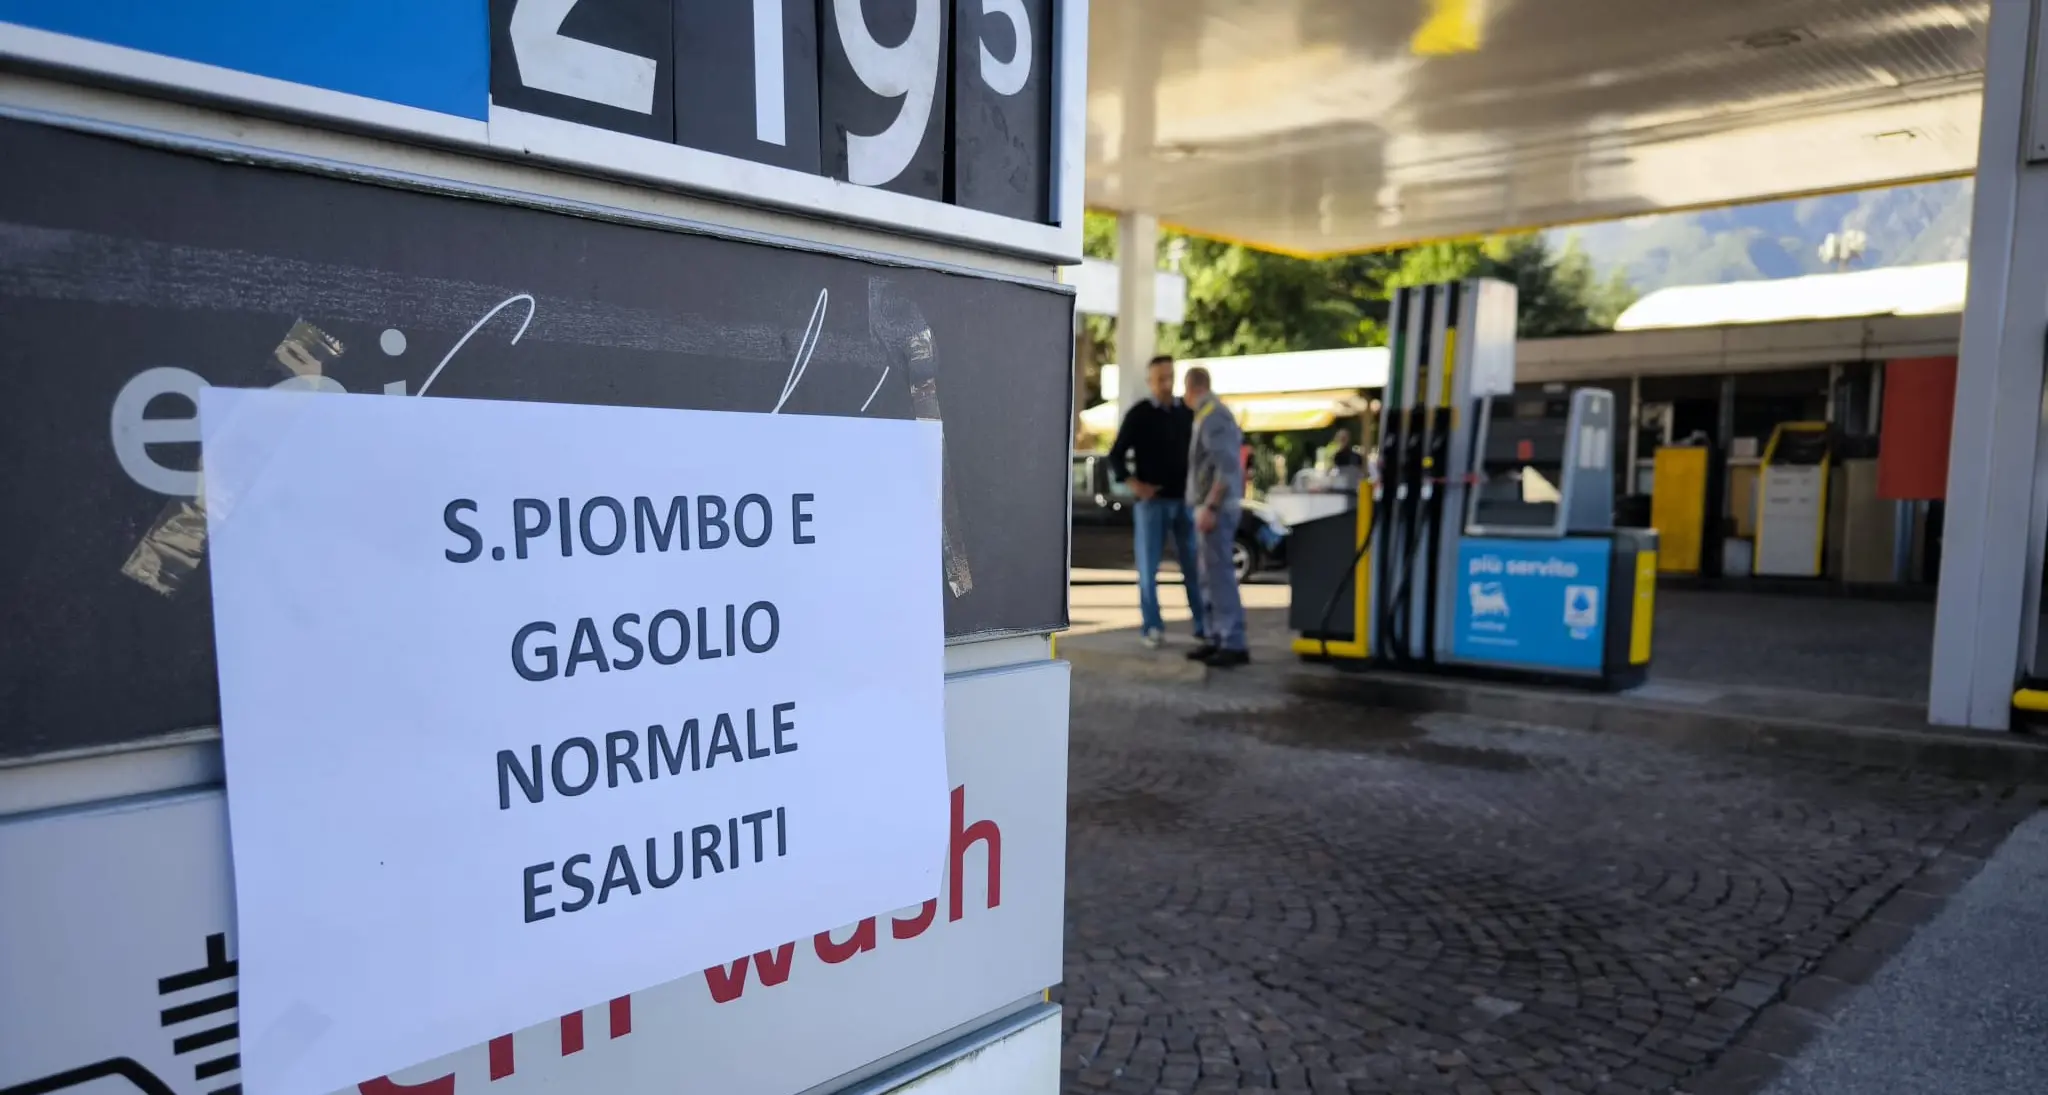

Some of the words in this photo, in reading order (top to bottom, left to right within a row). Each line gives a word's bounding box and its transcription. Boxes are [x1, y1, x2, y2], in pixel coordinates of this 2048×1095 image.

[442, 492, 774, 565] S.PIOMBO
[790, 491, 817, 546] E
[510, 599, 781, 683] GASOLIO
[495, 700, 799, 812] NORMALE
[522, 805, 788, 925] ESAURITI
